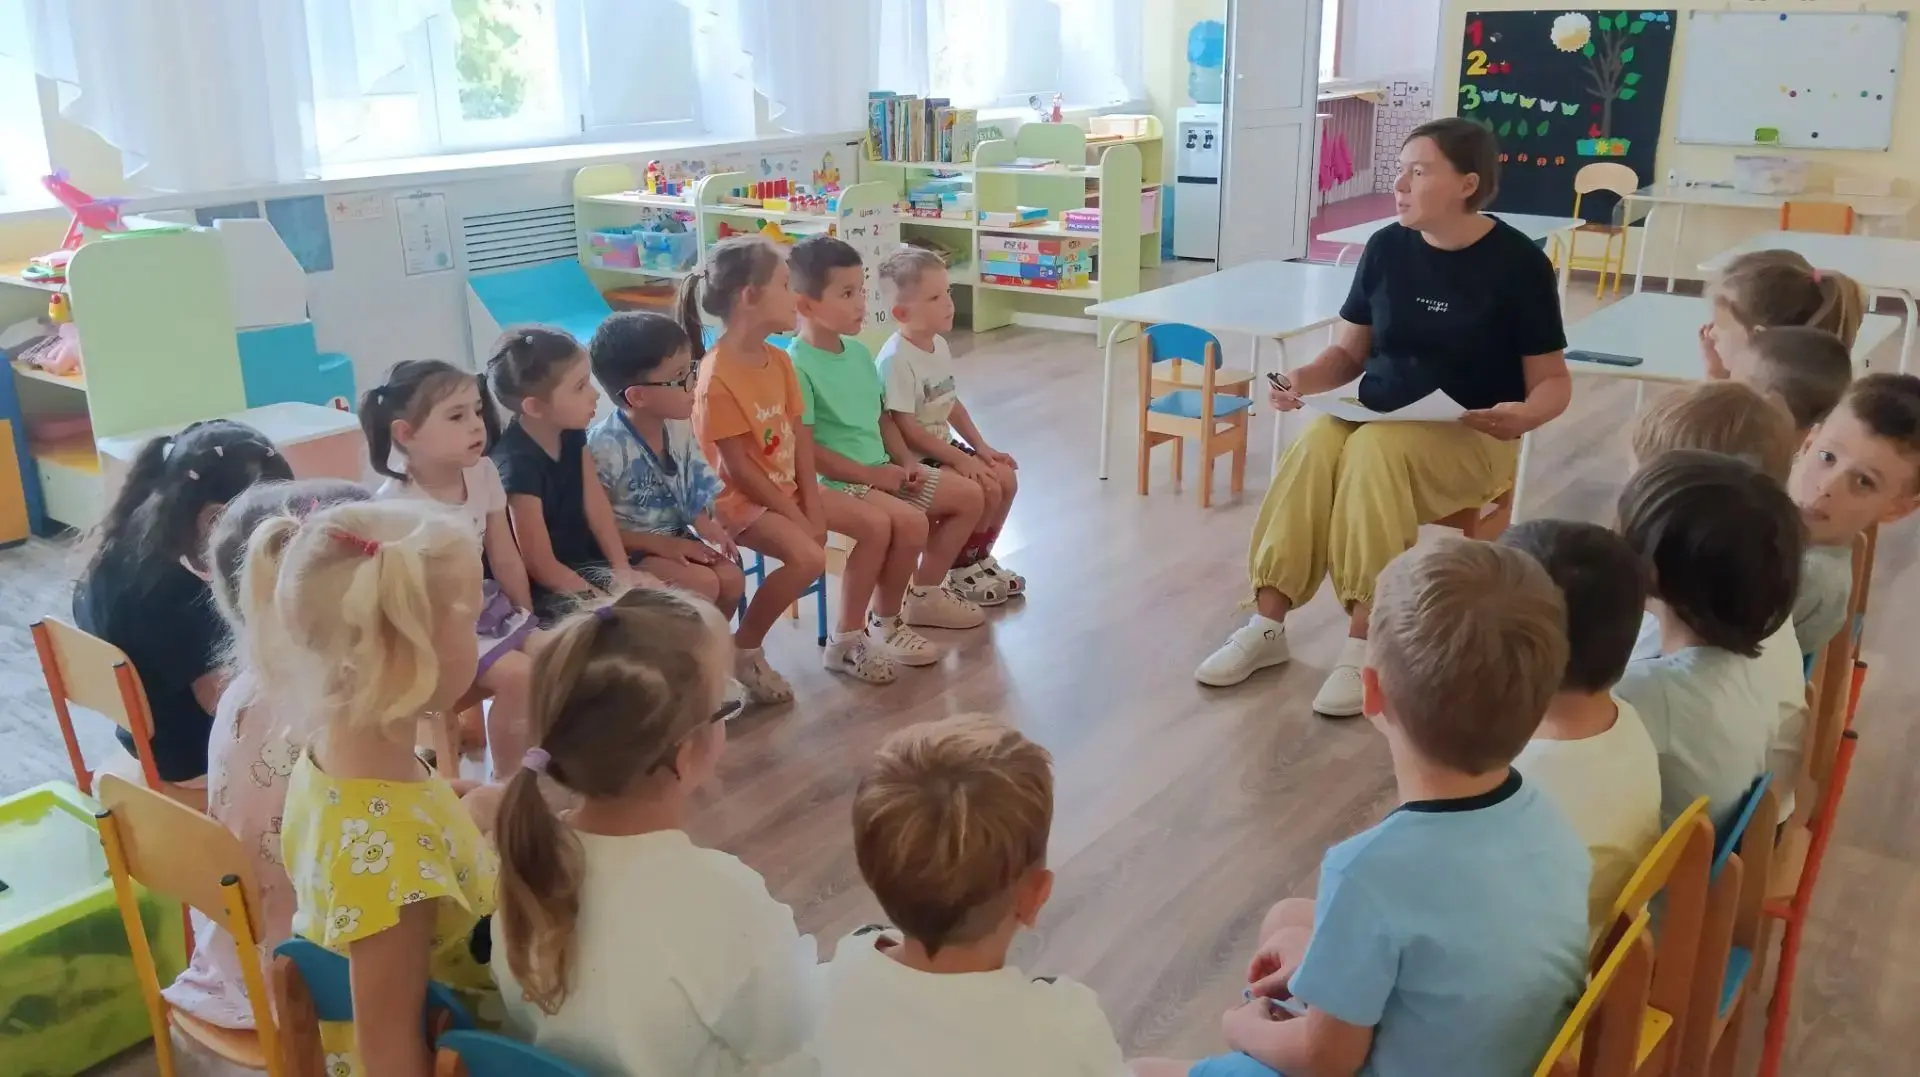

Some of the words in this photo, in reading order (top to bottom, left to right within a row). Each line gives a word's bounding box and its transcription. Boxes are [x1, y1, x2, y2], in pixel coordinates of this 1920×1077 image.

[1466, 20, 1483, 47] 1
[1466, 50, 1488, 75] 2
[1459, 84, 1481, 110] 3
[873, 224, 879, 236] 2
[875, 310, 886, 322] 10
